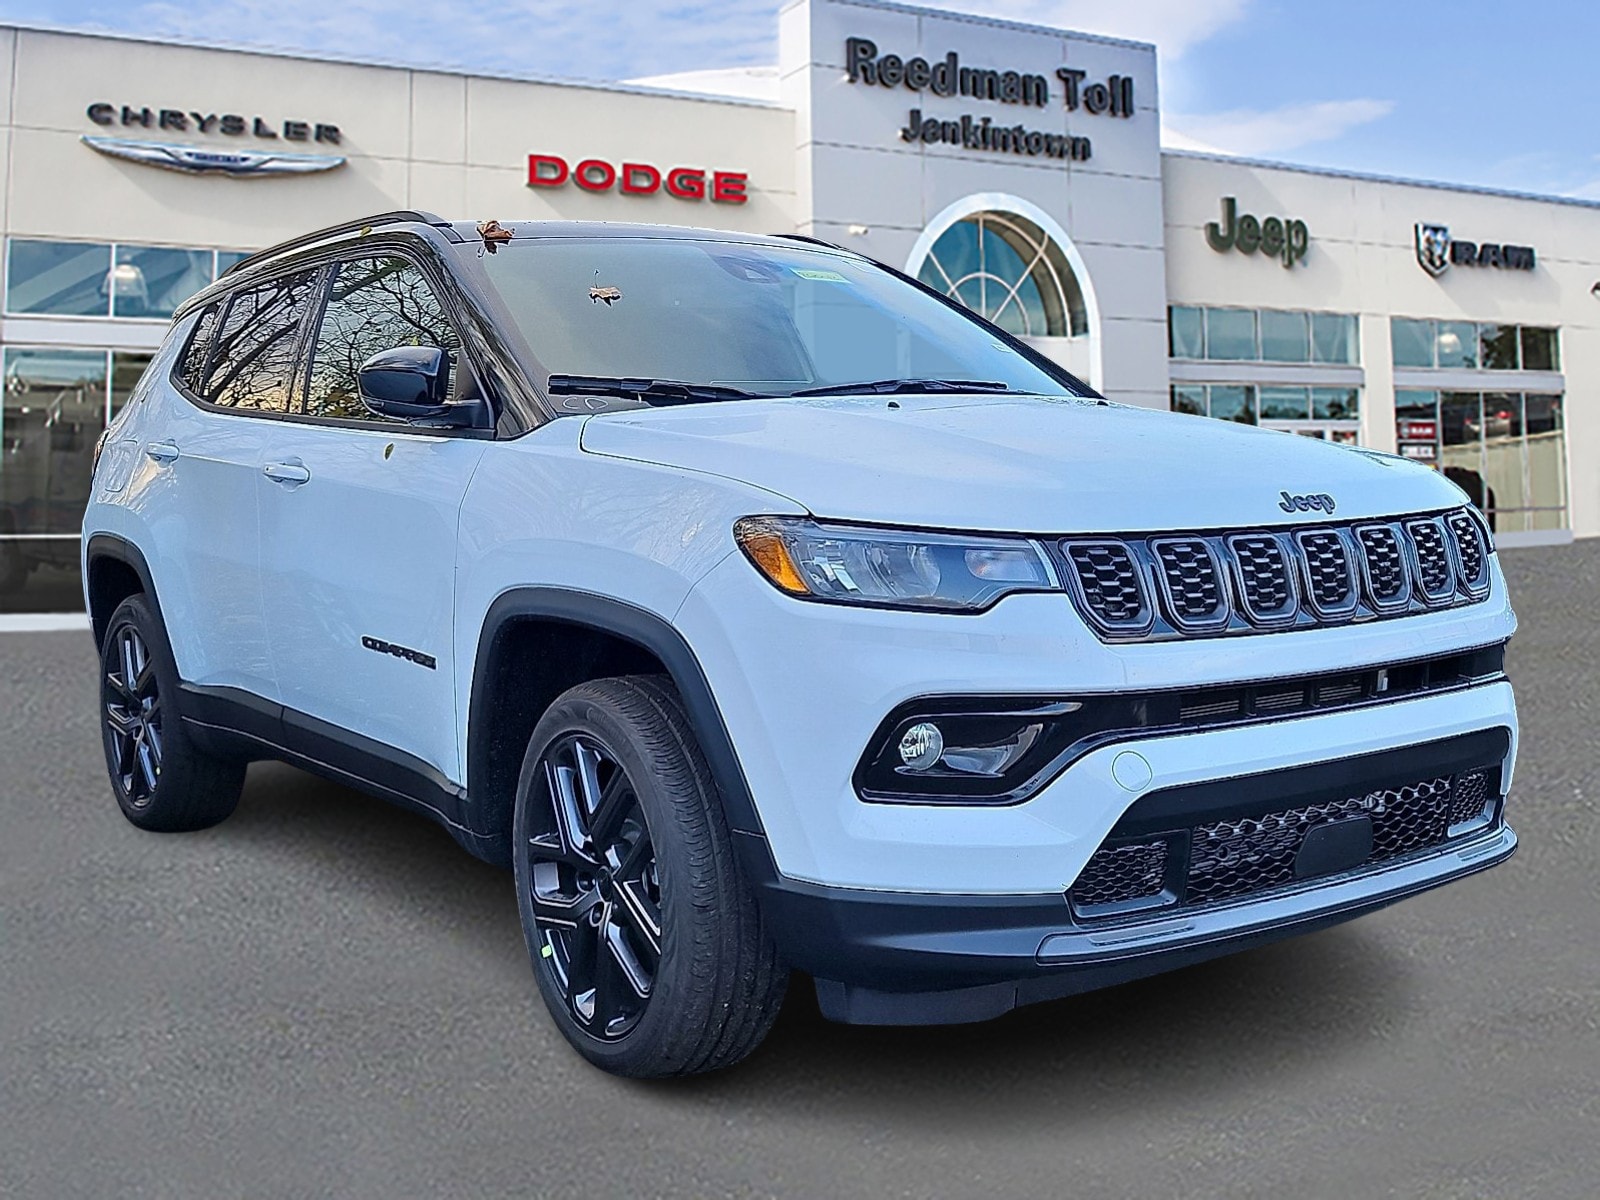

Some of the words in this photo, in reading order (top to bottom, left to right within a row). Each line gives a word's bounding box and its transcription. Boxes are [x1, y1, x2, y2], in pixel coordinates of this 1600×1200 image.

[845, 37, 1048, 108] Reedman
[1057, 67, 1135, 118] Toll
[86, 102, 342, 145] CHRYSLER
[901, 109, 1092, 161] Jenkintown
[528, 154, 749, 205] DODGE
[1204, 197, 1309, 269] Jeep
[1450, 241, 1536, 270] RAM
[1278, 491, 1336, 515] Jeep
